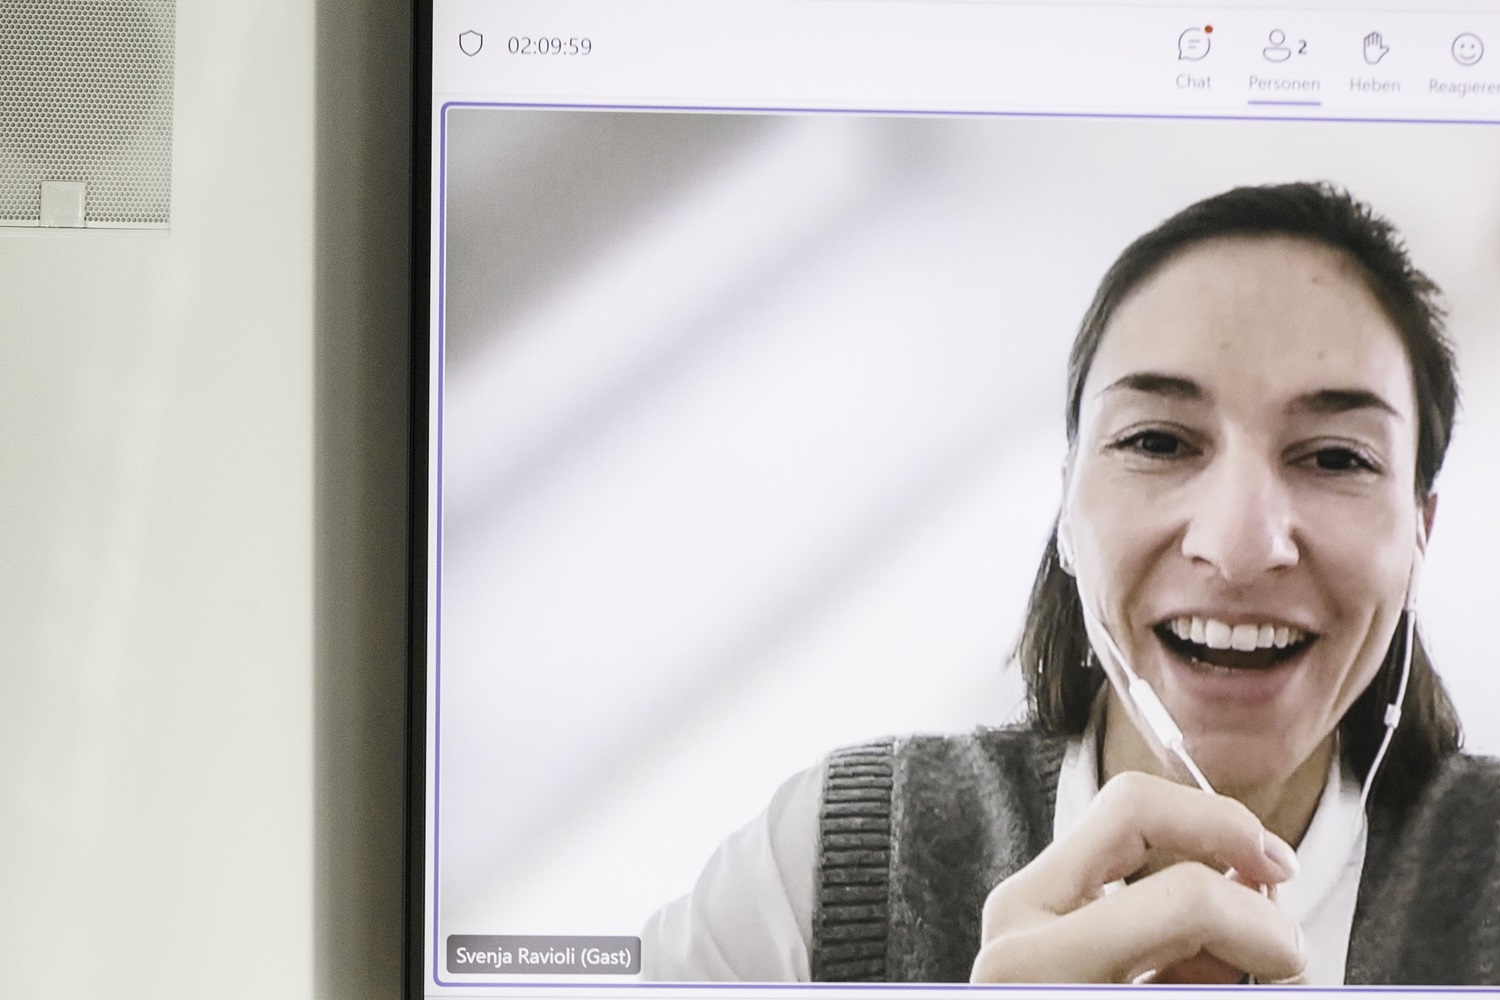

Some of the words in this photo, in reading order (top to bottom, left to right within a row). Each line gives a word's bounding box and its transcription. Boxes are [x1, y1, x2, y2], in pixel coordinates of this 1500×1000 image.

[507, 36, 592, 55] 02:09:59
[1297, 39, 1308, 55] 2
[1175, 73, 1211, 90] Chat
[1248, 74, 1321, 92] Personen
[1349, 77, 1401, 93] Heben
[456, 946, 513, 969] Svenja
[518, 946, 576, 966] Ravioli
[580, 947, 632, 970] (Gast)
